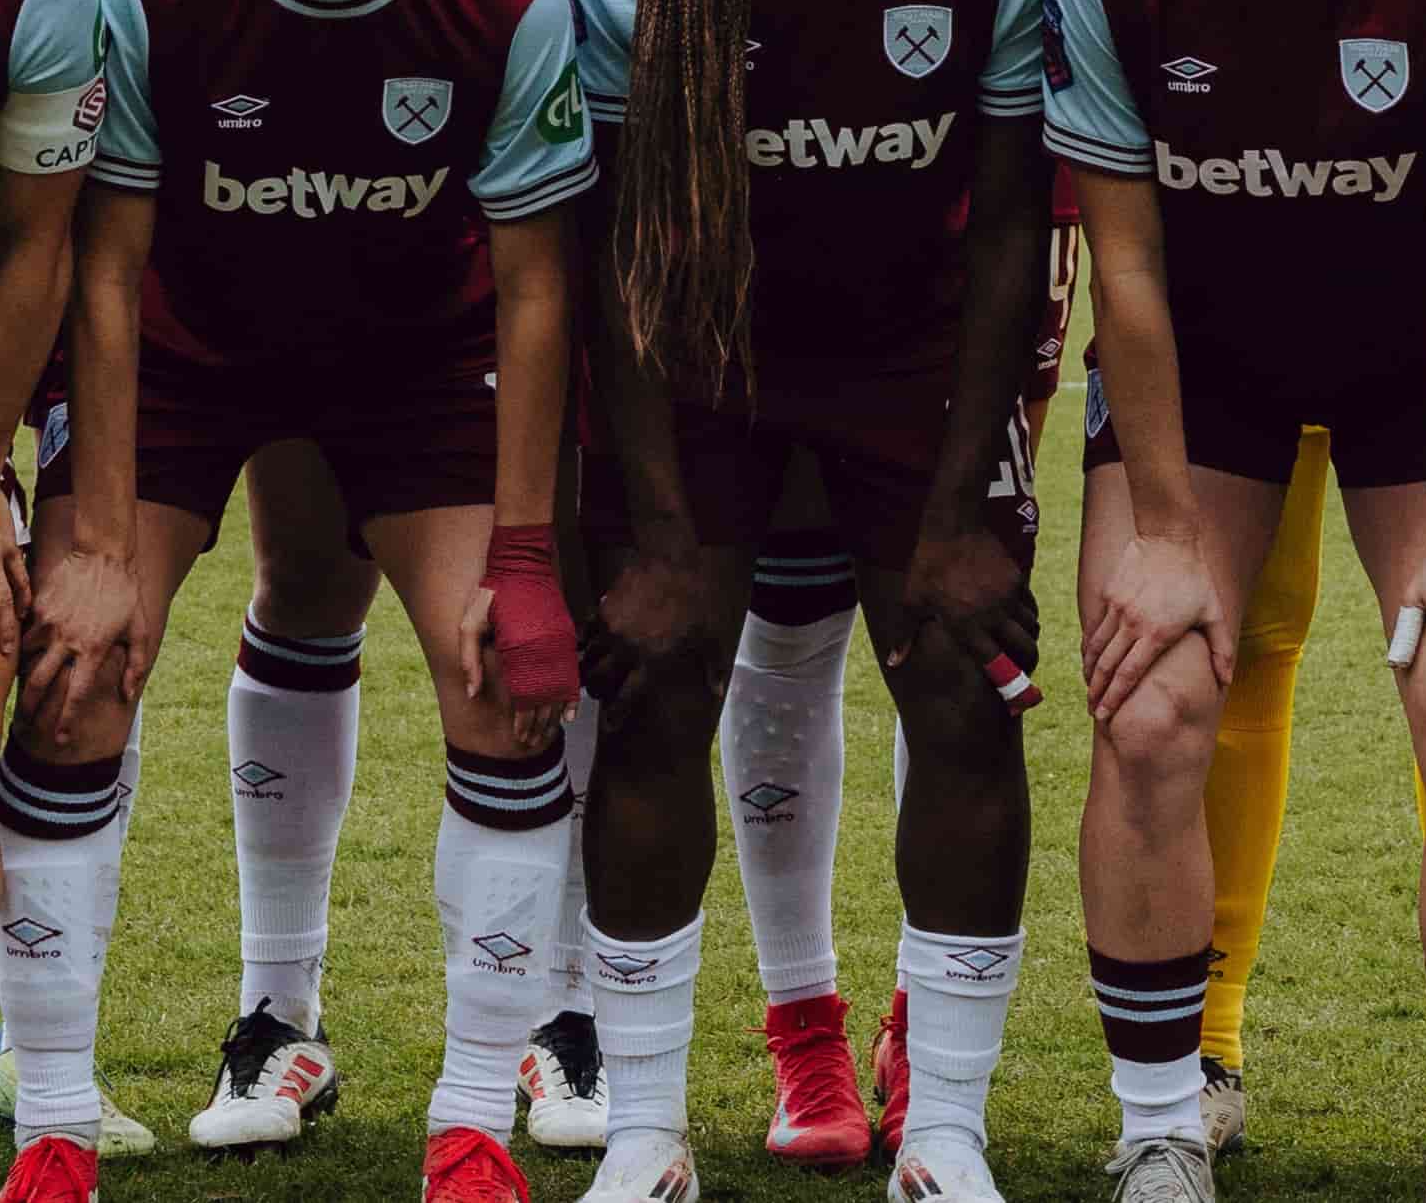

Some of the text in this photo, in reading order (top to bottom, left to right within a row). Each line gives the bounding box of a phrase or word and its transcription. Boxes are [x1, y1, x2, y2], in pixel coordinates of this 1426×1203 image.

[1167, 80, 1211, 94] umbro
[218, 115, 263, 129] umbro
[745, 112, 956, 169] etway
[1154, 140, 1416, 202] betway
[204, 160, 450, 218] betway
[235, 788, 284, 801] umbro
[743, 811, 794, 824] umbro
[6, 944, 62, 959] umbro
[472, 956, 527, 976] umbro
[598, 967, 657, 986] umbro
[944, 970, 1006, 982] umbro
